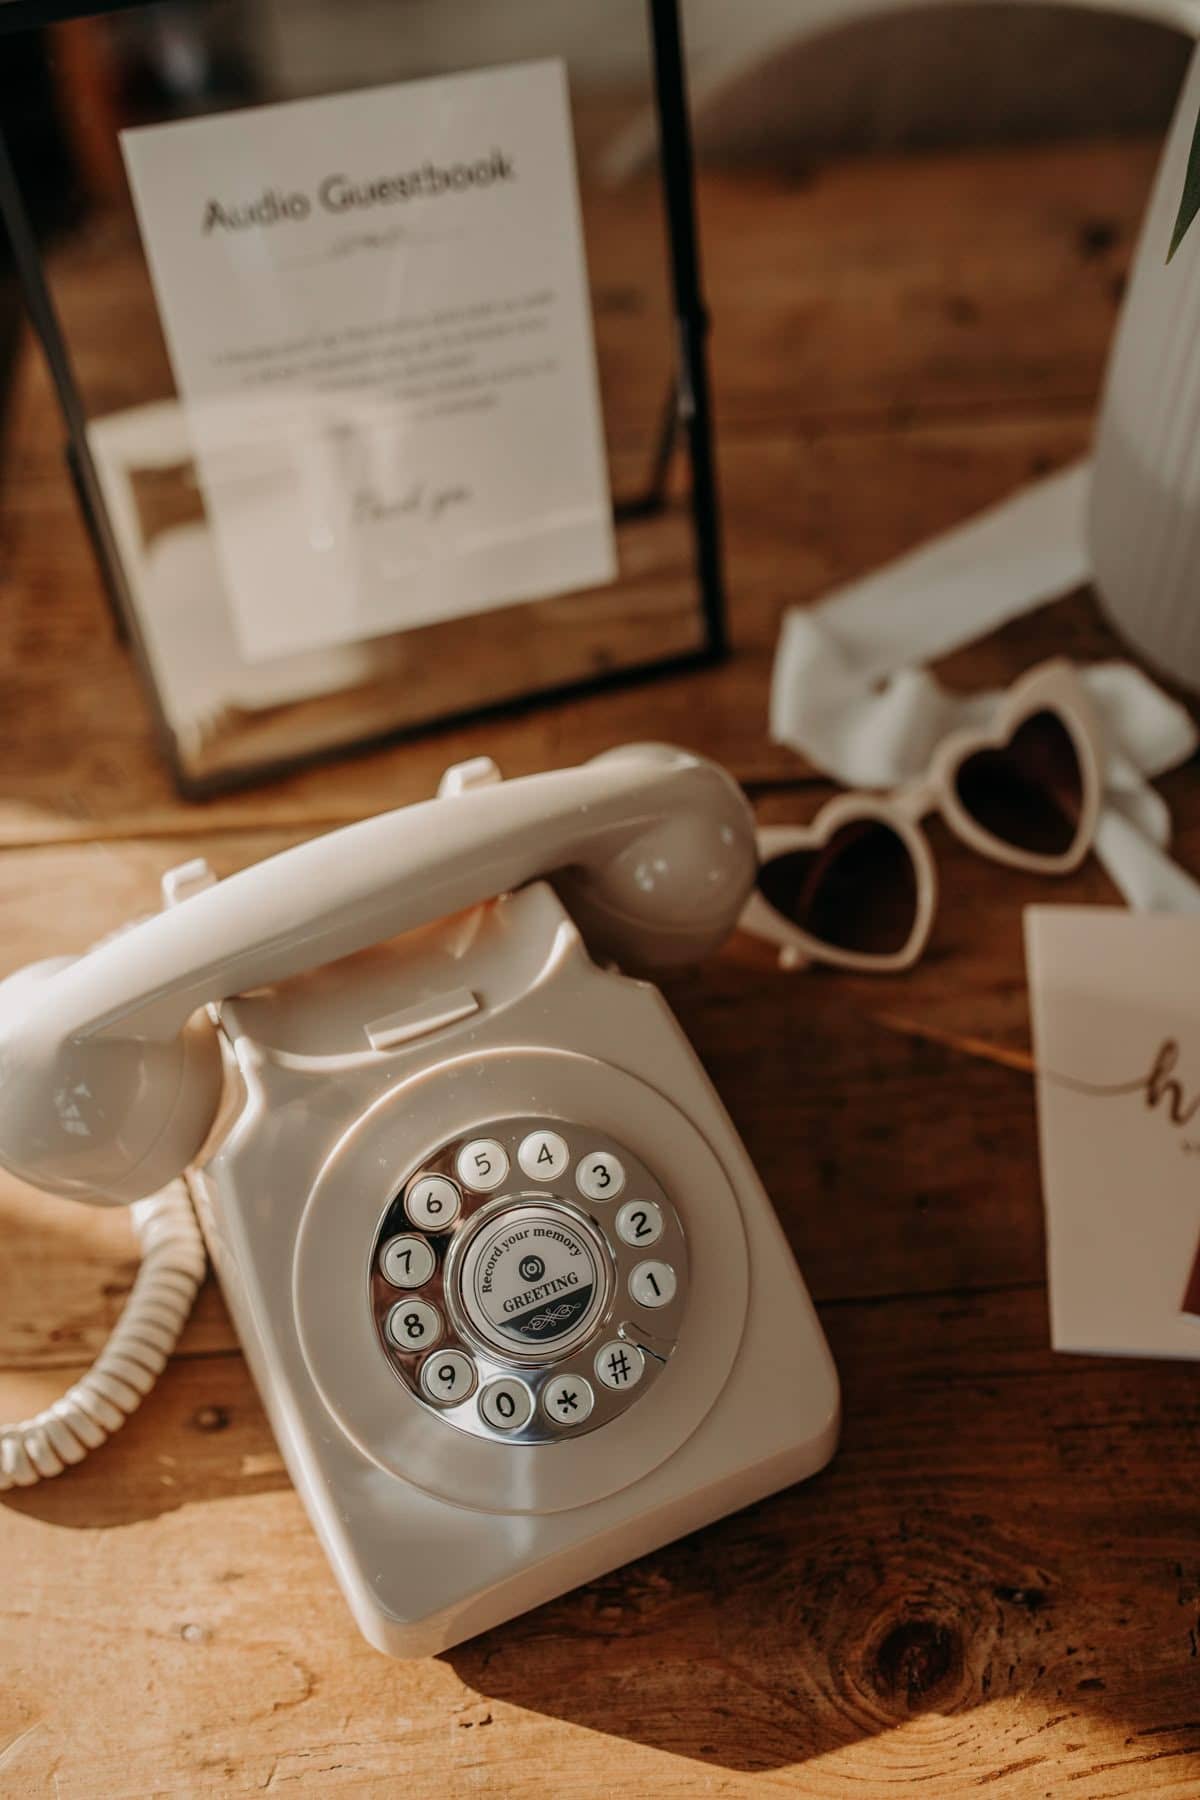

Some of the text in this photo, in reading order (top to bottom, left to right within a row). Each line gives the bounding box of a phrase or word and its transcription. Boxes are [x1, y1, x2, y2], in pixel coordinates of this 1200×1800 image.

[203, 148, 516, 236] Audio Guestbook
[474, 1153, 492, 1176] 5
[536, 1142, 554, 1166] 4
[591, 1164, 611, 1188] 3
[426, 1192, 443, 1214] 6
[629, 1211, 652, 1238] 2
[396, 1249, 413, 1274] 7
[482, 1228, 582, 1294] Record your memory
[503, 1271, 579, 1313] GREETING
[645, 1273, 661, 1297] 1
[404, 1313, 425, 1338] 8
[438, 1365, 456, 1390] 9
[607, 1349, 631, 1384] #
[496, 1391, 516, 1418] 0
